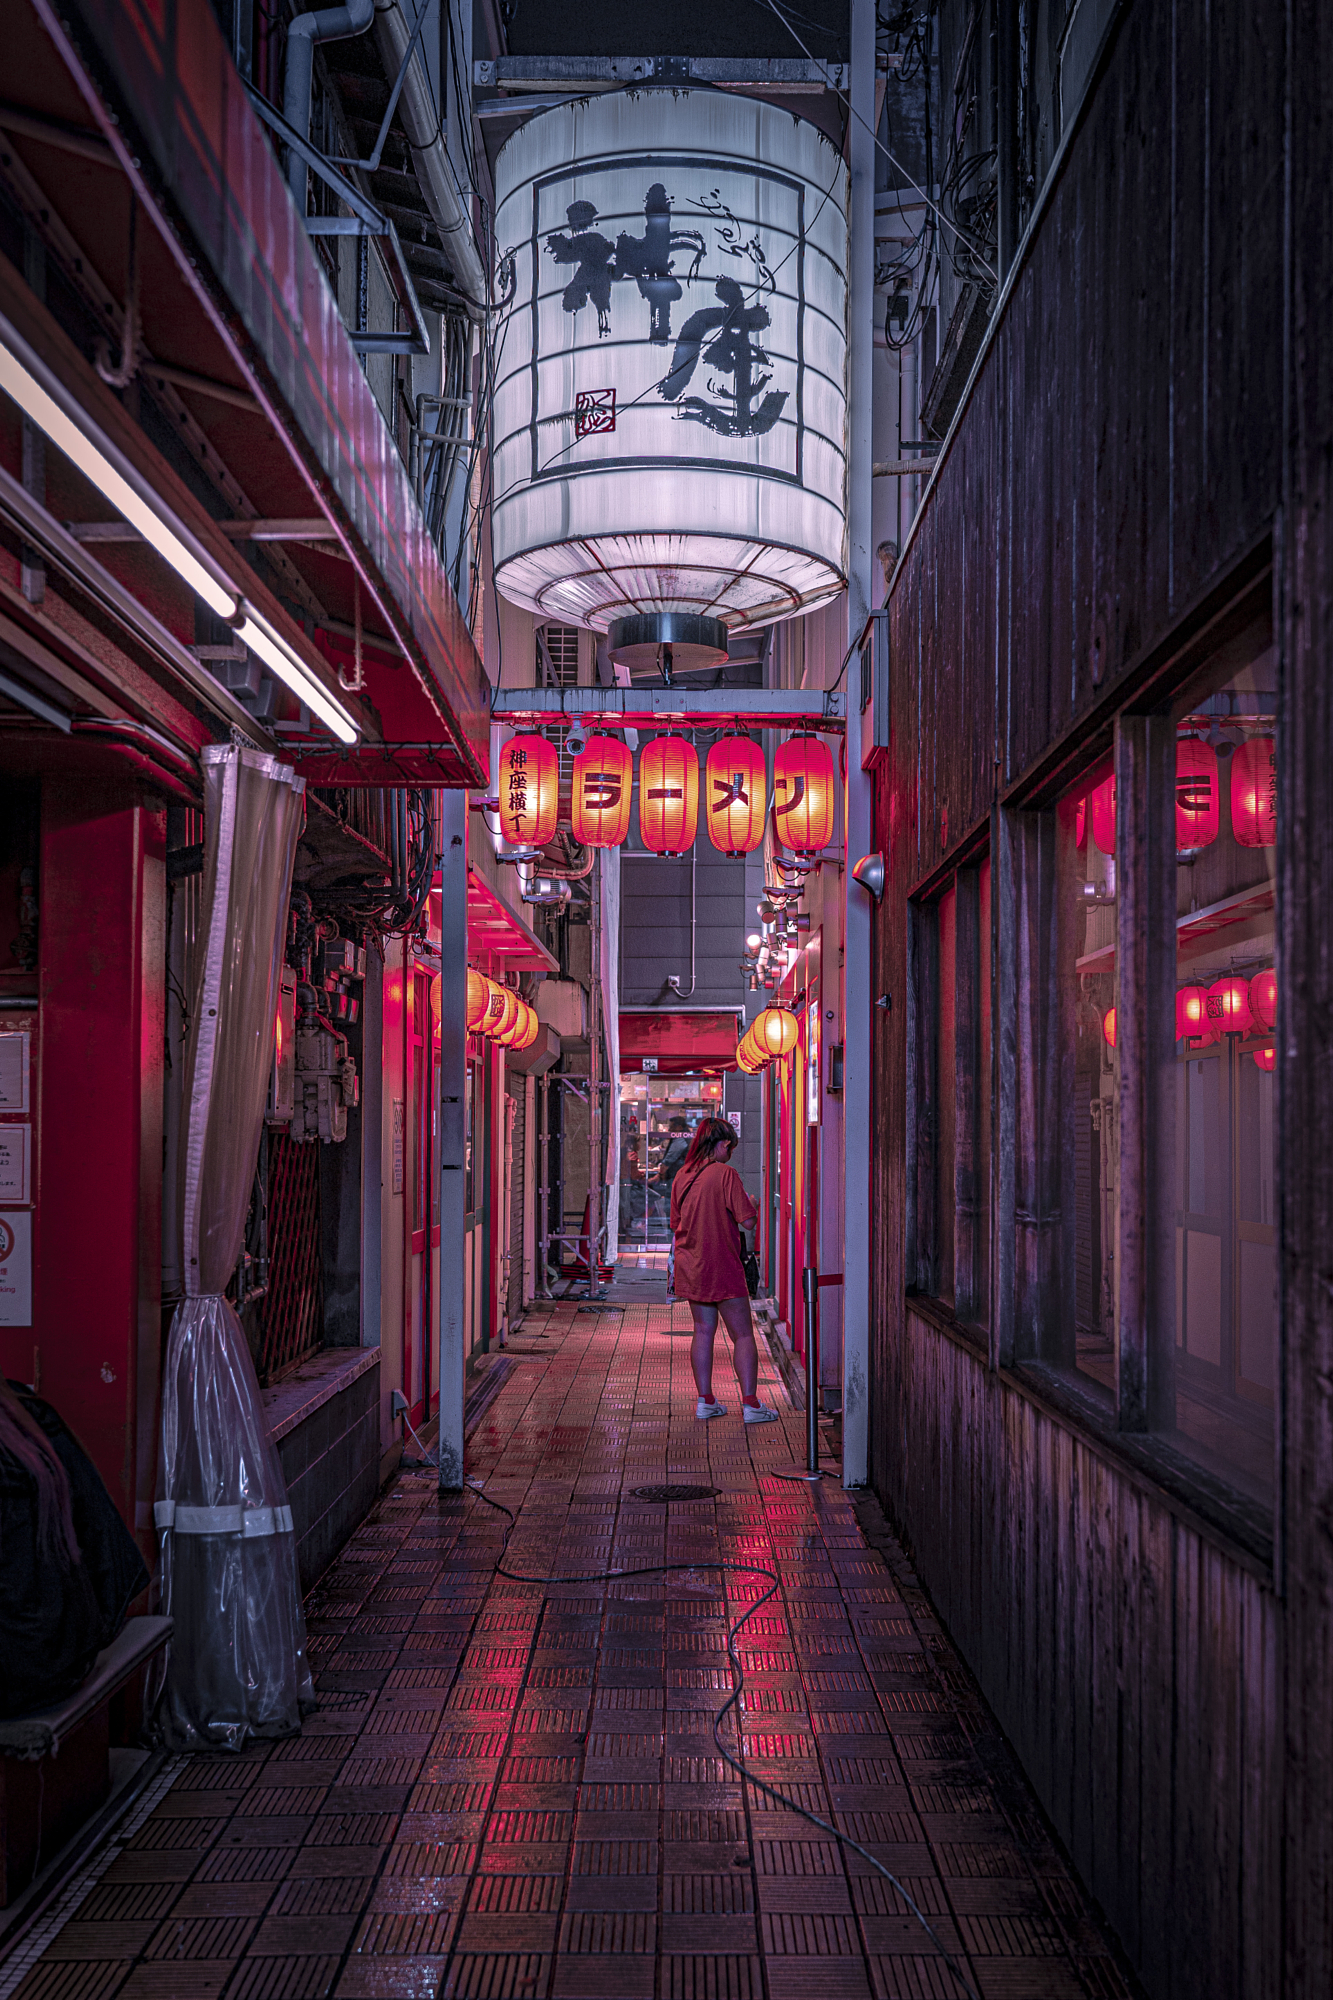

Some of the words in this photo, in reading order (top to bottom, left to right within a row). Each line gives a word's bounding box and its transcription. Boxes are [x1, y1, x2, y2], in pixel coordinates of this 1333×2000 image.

[685, 188, 777, 297] どうとんぼり
[544, 183, 790, 438] 神座
[508, 748, 527, 833] 神座横丁
[583, 773, 805, 817] ラーメン
